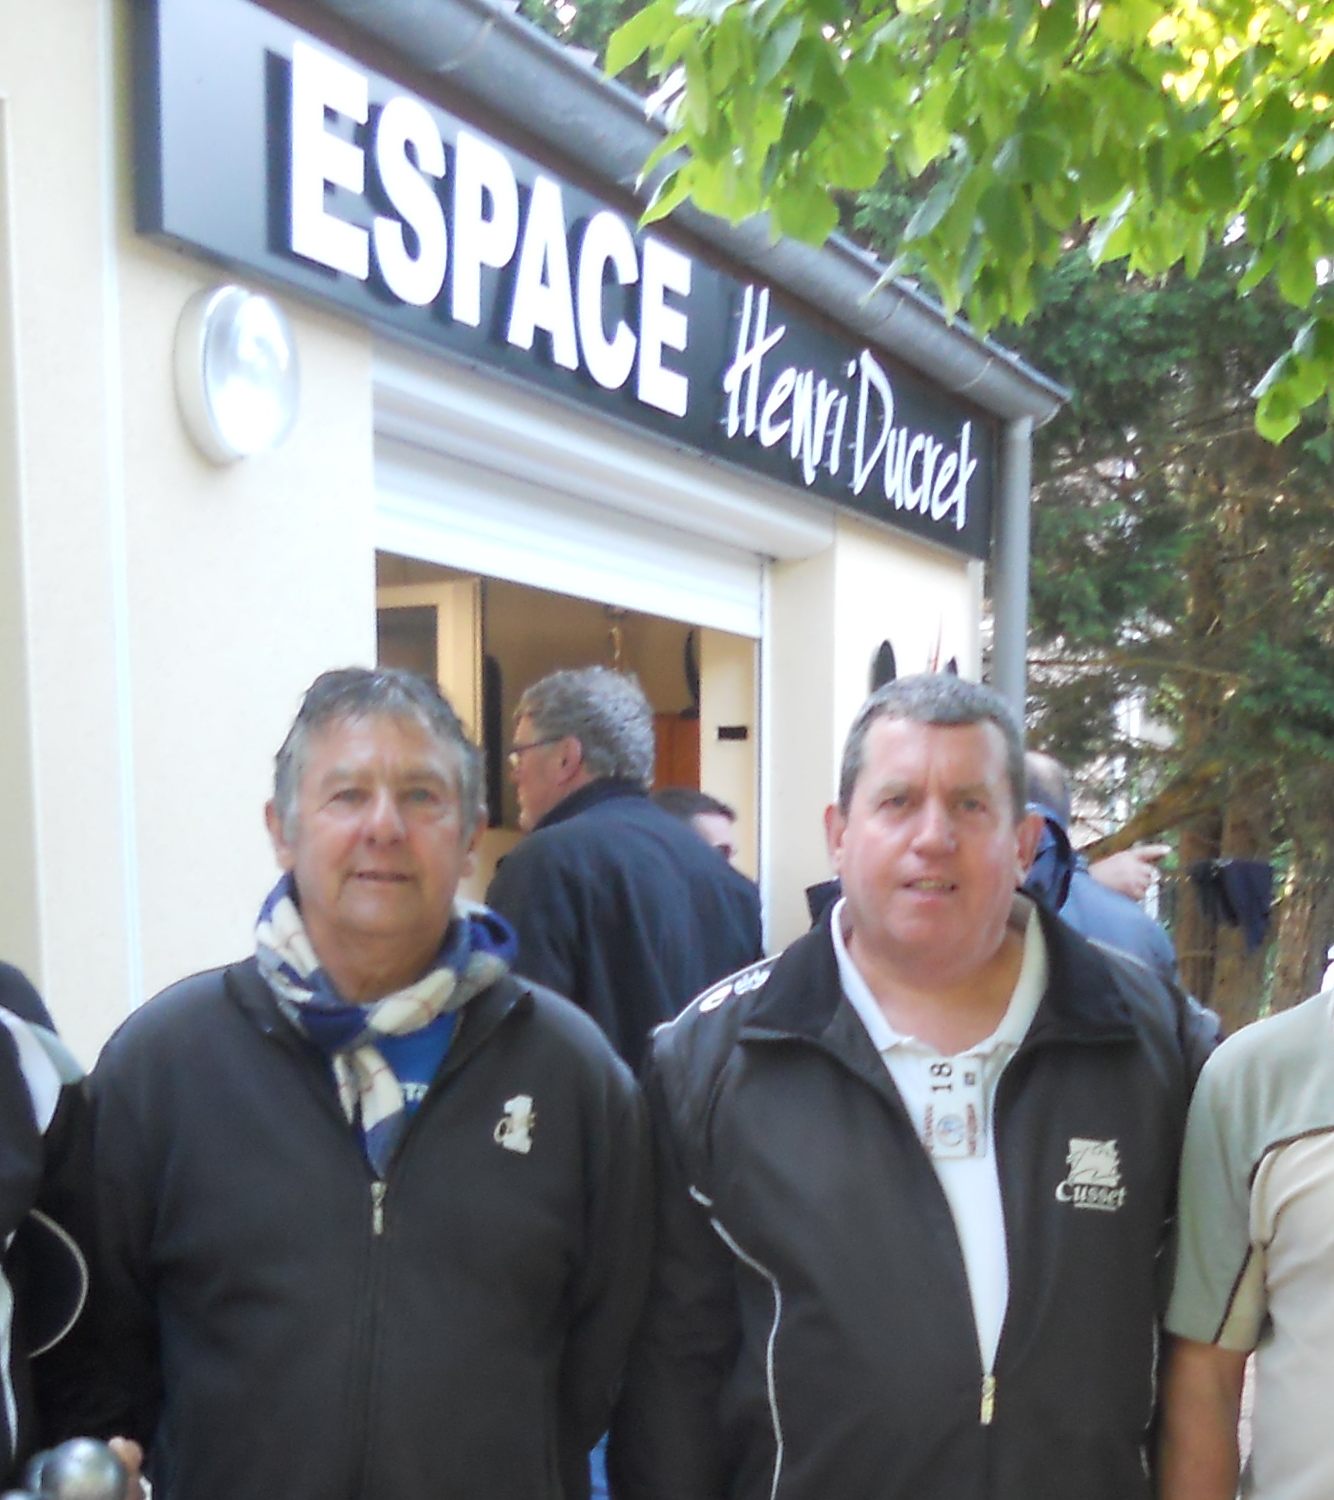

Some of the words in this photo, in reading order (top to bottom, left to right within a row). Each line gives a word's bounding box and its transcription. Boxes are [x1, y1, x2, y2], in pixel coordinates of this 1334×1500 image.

[291, 40, 692, 419] ESPACE
[723, 284, 857, 486] Henri
[853, 348, 978, 531] Ducret
[929, 1063, 953, 1093] 18
[1054, 1180, 1127, 1207] Cusset
